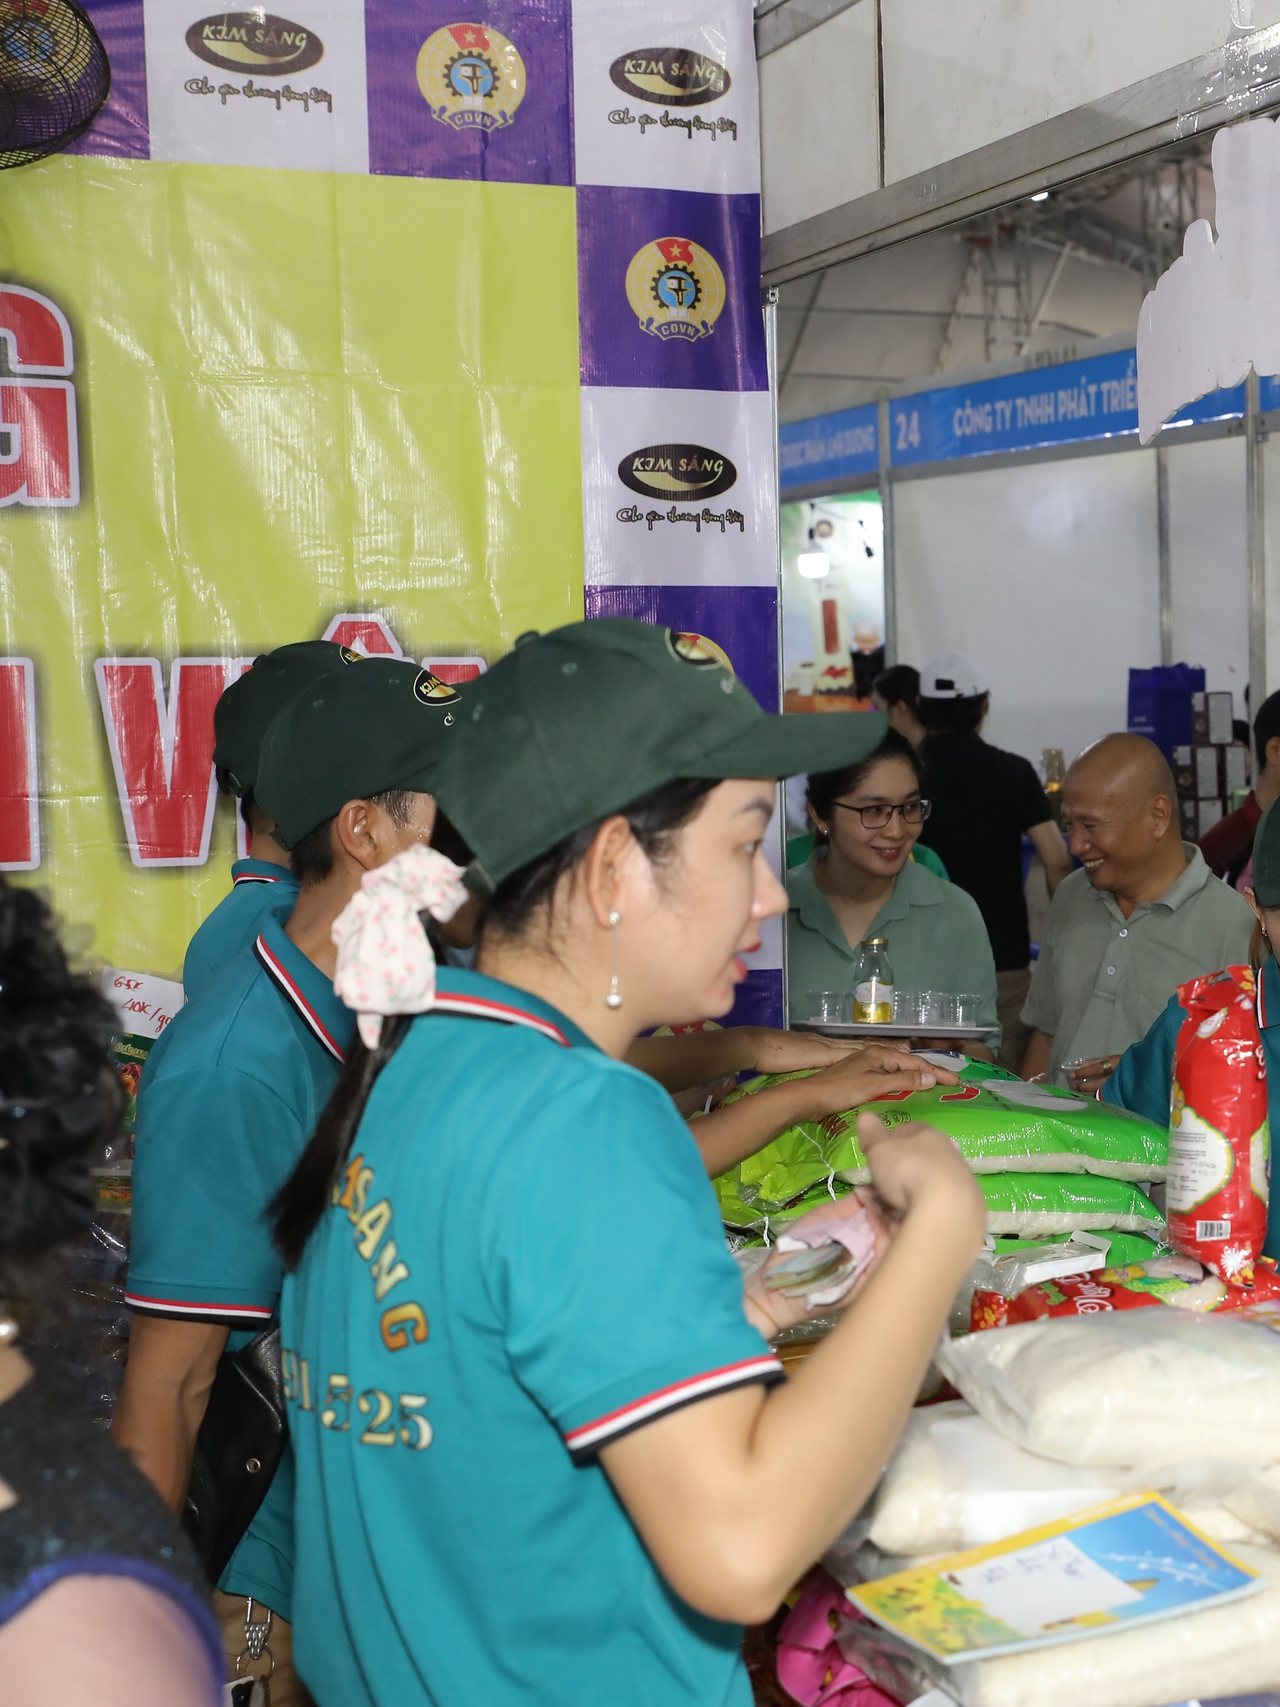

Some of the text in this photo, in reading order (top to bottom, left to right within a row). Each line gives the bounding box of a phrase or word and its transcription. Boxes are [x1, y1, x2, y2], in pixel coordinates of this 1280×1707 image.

[202, 25, 248, 41] KIM
[624, 59, 665, 74] KIM
[953, 358, 1138, 437] CÔNG TY TNHH PHÁT TRIỂ
[895, 410, 921, 450] 24
[633, 457, 673, 470] KIM
